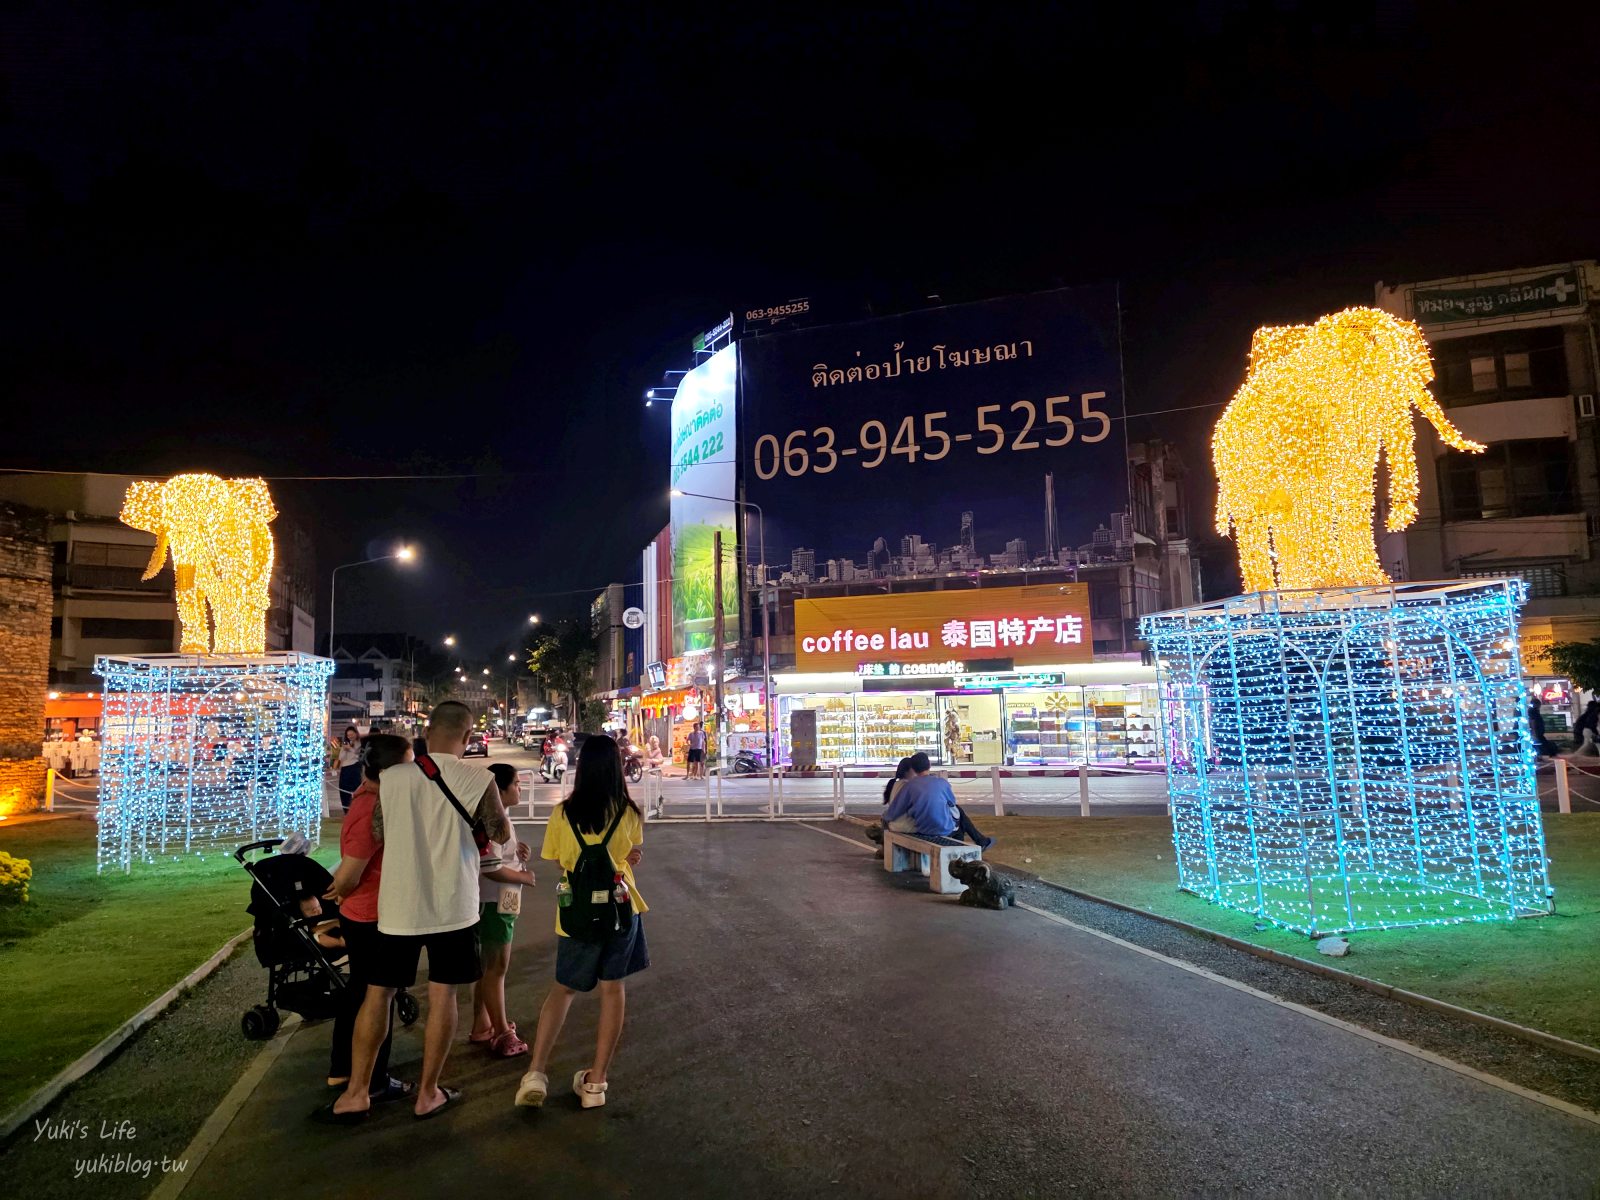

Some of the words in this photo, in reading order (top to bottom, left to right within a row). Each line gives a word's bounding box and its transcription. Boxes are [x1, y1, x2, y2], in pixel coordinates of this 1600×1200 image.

[746, 300, 810, 320] 063-9455255
[811, 340, 1034, 388] ติดต่อป้ายโฆษณา
[753, 391, 1112, 481] 063-945-5255
[801, 629, 885, 653] coffee
[890, 627, 929, 650] lau
[941, 614, 1083, 648] 泰国特产店
[902, 660, 964, 675] cosmetic
